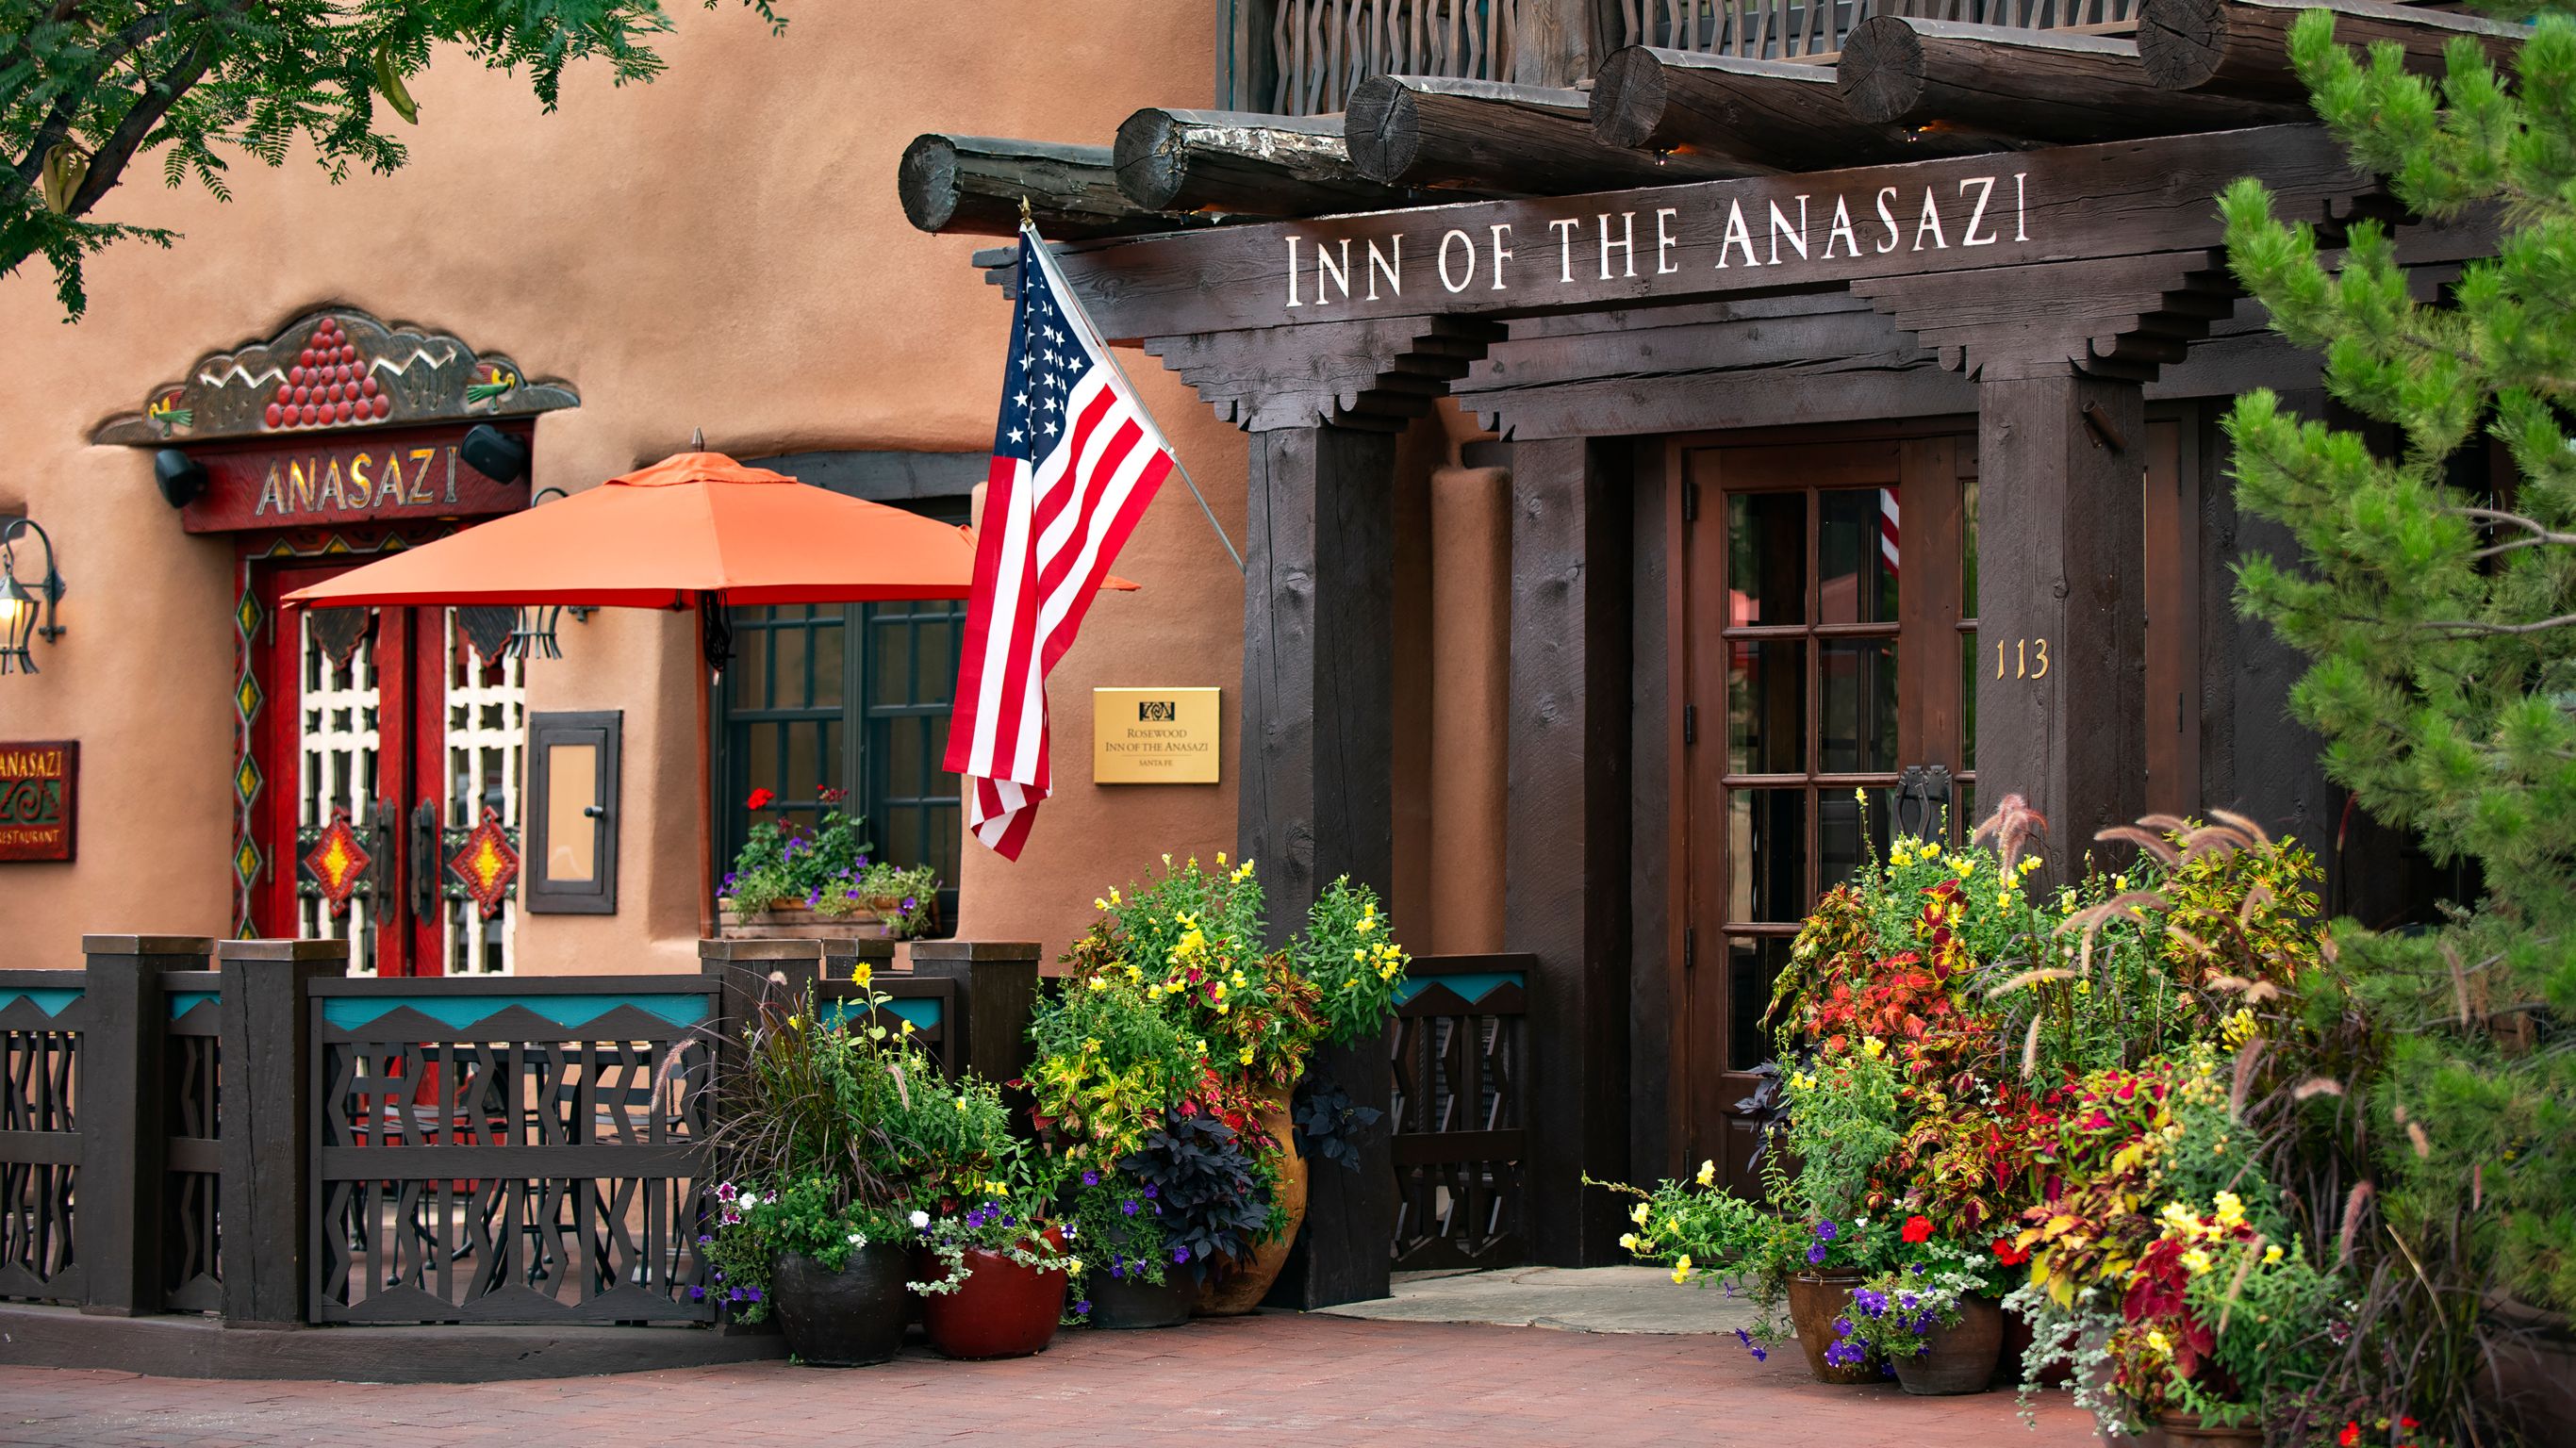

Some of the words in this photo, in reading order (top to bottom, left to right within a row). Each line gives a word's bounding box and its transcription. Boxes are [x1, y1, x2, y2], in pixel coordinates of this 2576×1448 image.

[1285, 233, 1404, 307] INN
[1438, 223, 1512, 293] OF
[1549, 207, 1678, 283] THE
[1714, 173, 2030, 270] ANASAZI
[256, 445, 459, 516] ANASAZI
[1997, 638, 2049, 680] 113
[1105, 742, 1125, 752] INN
[1127, 743, 1140, 752] OF
[1142, 743, 1163, 752] THE
[1164, 742, 1208, 752] ANASAZI
[1127, 728, 1187, 739] ROSEWOOD
